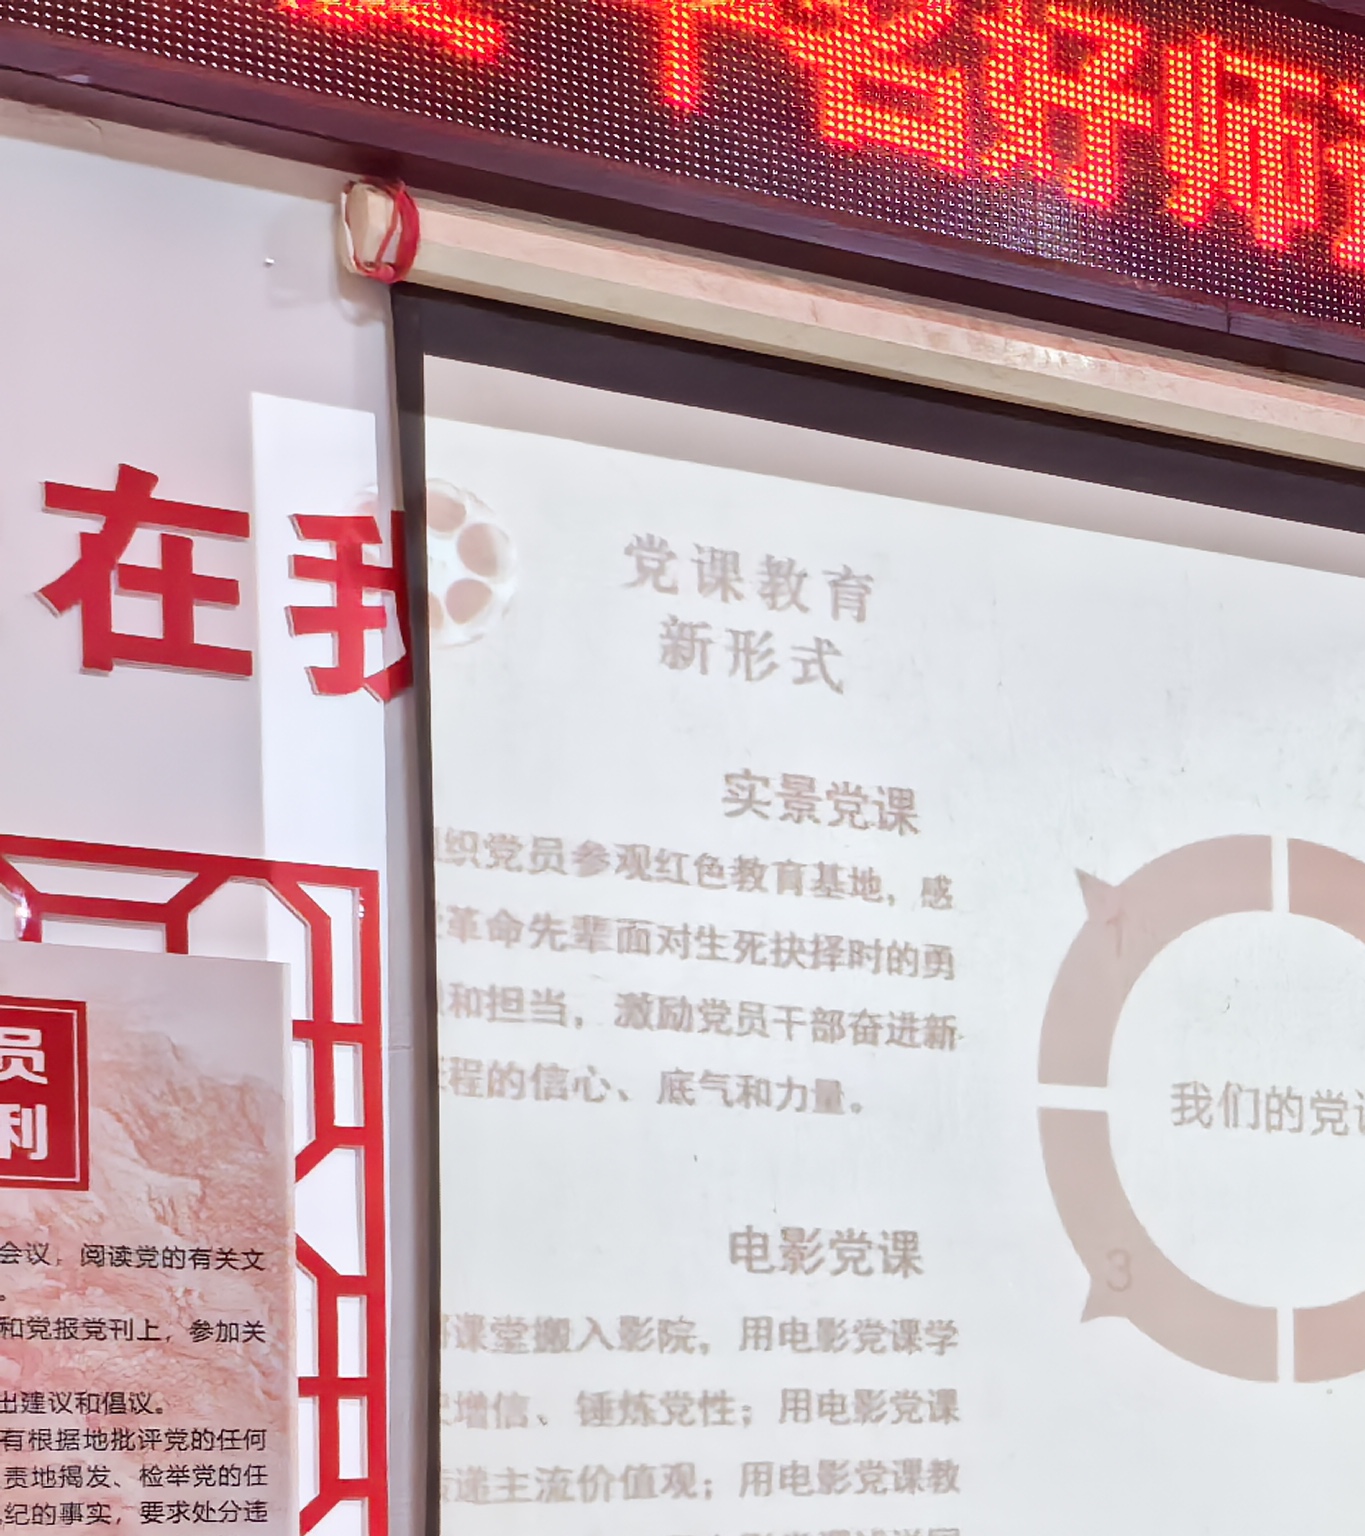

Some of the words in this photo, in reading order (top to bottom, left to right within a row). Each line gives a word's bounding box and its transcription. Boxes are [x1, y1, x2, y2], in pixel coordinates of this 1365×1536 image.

[623, 532, 875, 624] 党课教育
[658, 614, 845, 694] 新形式
[720, 768, 923, 837] 实景党课
[435, 902, 957, 982] 革命先辈面对生死抉择时的勇
[437, 980, 959, 1052] 和担当，激励党员干部奋进新
[437, 1056, 865, 1115] 程的信心、底气和力量。
[728, 1226, 925, 1279] 电影党课
[440, 1313, 960, 1357] 课堂搬入影院，用电影党课学
[0, 1501, 269, 1527] 纪的事实，要求处分违
